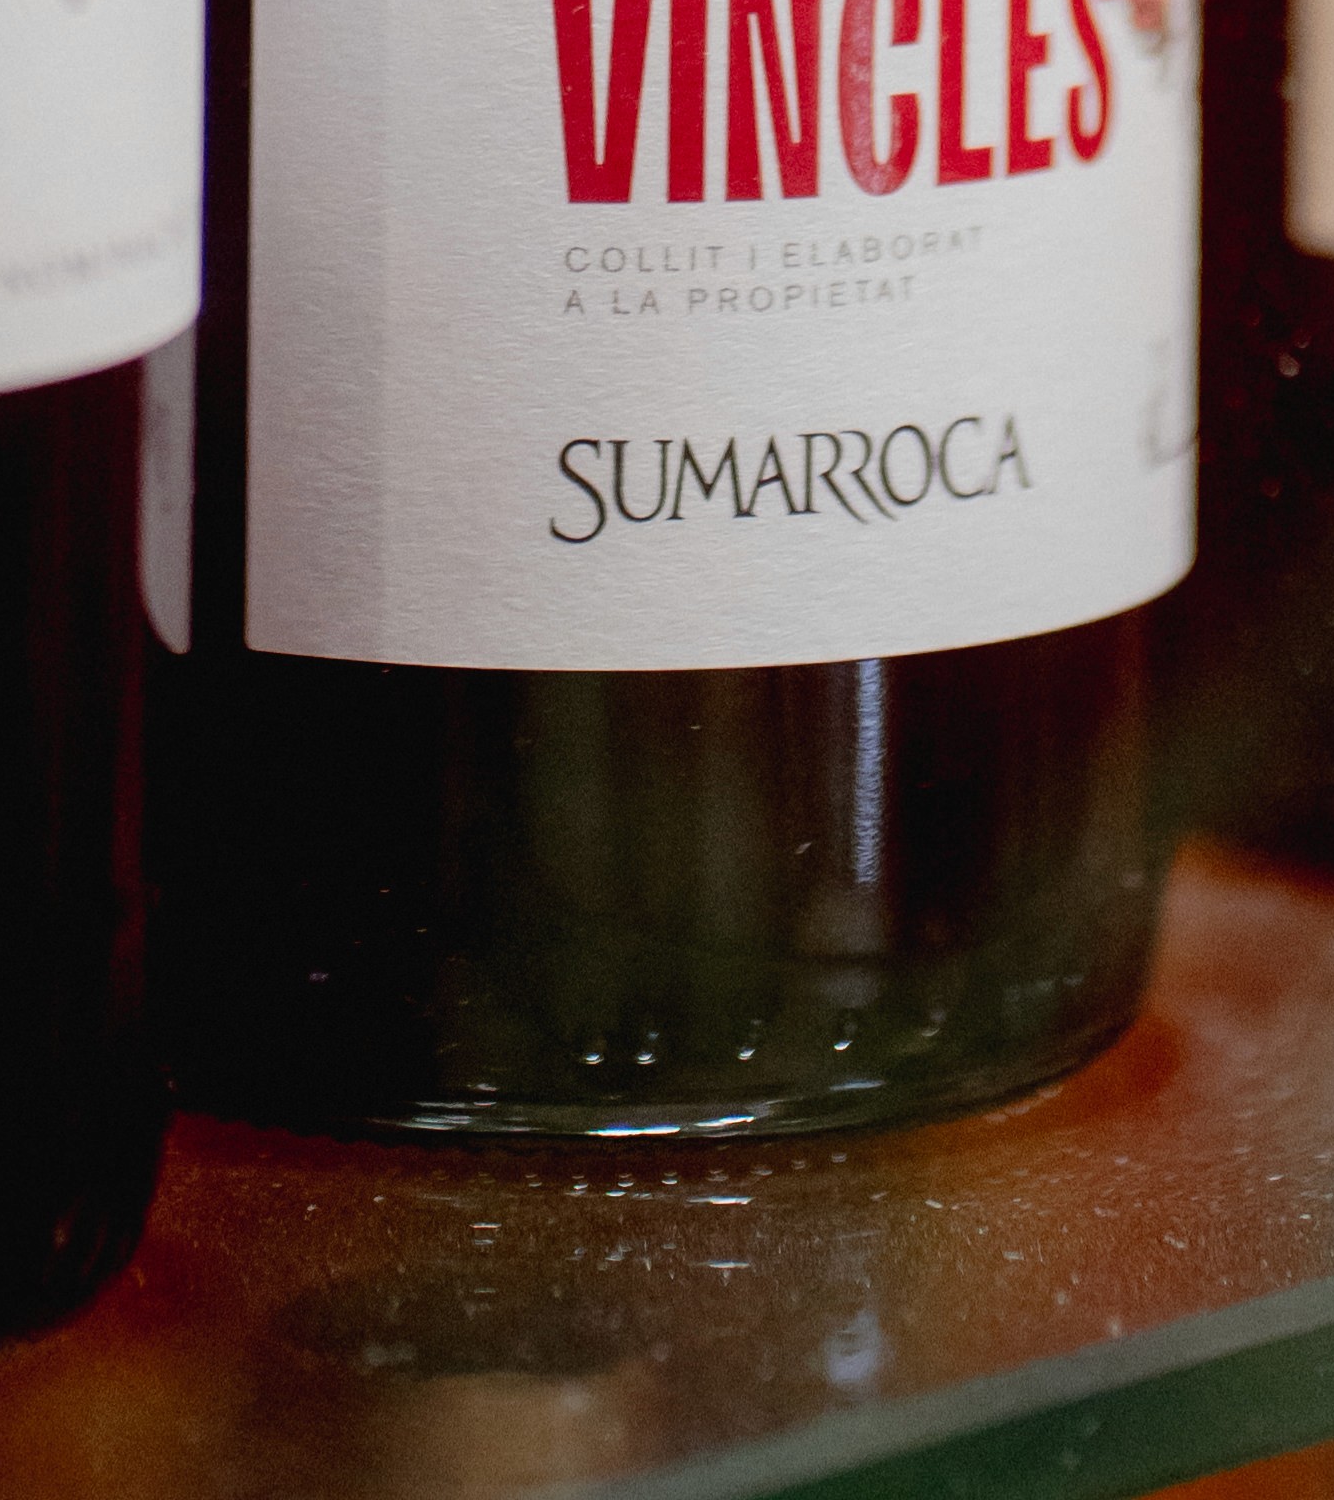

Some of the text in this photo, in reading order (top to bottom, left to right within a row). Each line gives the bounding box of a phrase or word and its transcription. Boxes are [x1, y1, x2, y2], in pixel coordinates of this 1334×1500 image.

[565, 225, 985, 274] COLLIT I ELABORAT
[565, 275, 916, 315] A LA PROPIETAT
[548, 414, 1033, 544] SUMARROCA
